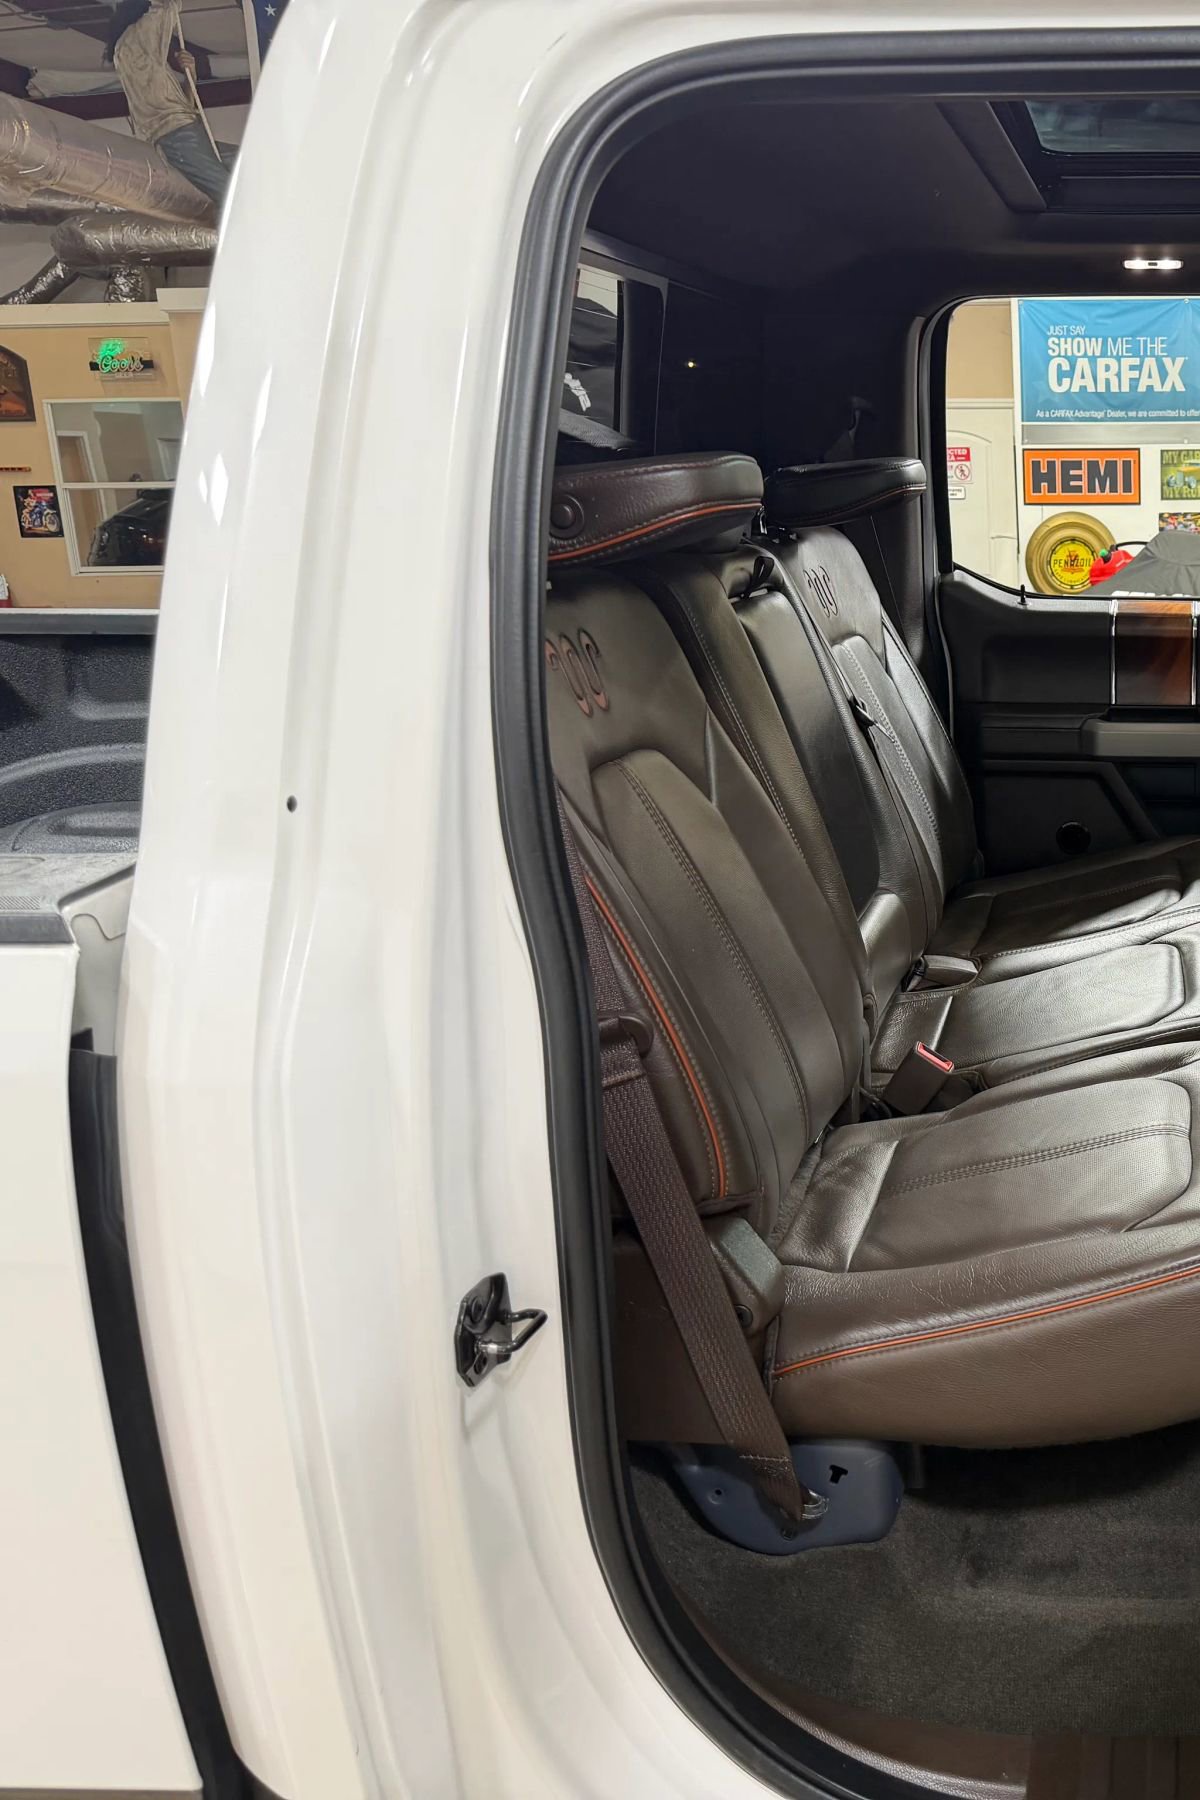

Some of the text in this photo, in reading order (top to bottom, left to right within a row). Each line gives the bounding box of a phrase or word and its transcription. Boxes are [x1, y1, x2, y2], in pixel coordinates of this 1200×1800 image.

[1047, 325, 1085, 335] JUST SAY
[1047, 337, 1167, 356] SHOW ME THE
[1048, 357, 1186, 393] CARFAX
[1036, 409, 1044, 418] As
[1148, 409, 1178, 417] committed
[1179, 409, 1186, 417] to
[1163, 451, 1179, 464] MY
[1031, 458, 1133, 495] HEMI
[1163, 485, 1181, 498] MY
